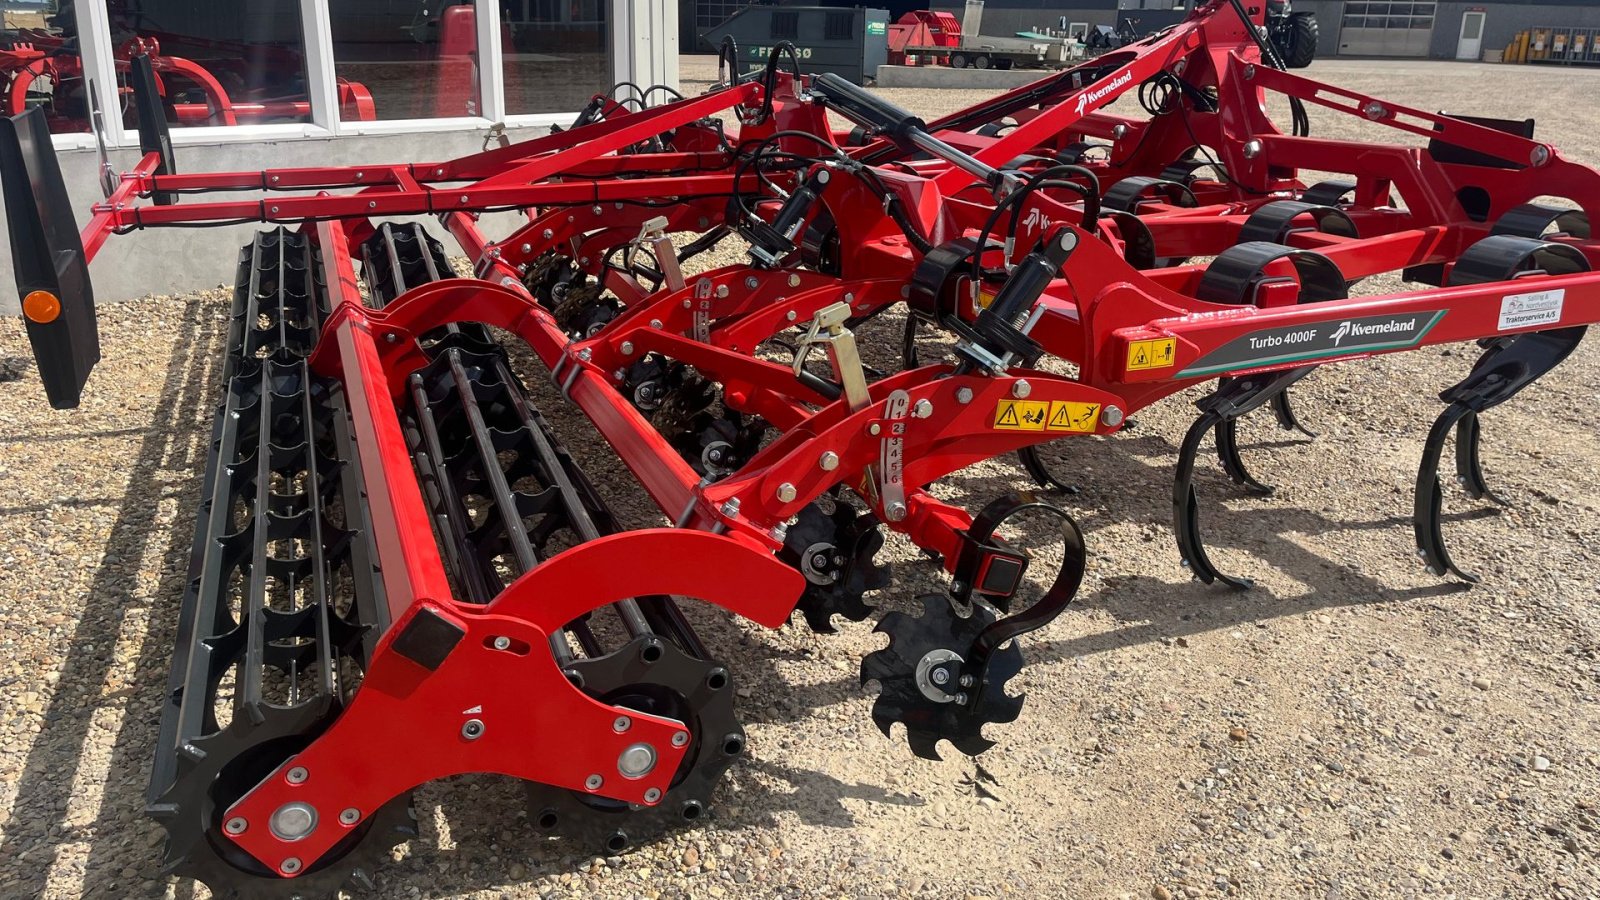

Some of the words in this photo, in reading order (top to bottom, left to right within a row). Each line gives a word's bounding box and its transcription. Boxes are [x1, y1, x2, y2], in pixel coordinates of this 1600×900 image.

[1087, 69, 1132, 104] Kverneland
[1506, 313, 1545, 323] Traktorservice
[1351, 318, 1416, 336] Kverneland
[1249, 336, 1283, 350] Turbo
[1284, 329, 1318, 344] 4000F
[898, 398, 905, 407] 0
[893, 424, 900, 432] 2
[891, 437, 898, 445] 3
[890, 449, 898, 457] 4
[891, 462, 897, 471] 5
[891, 474, 898, 483] 6
